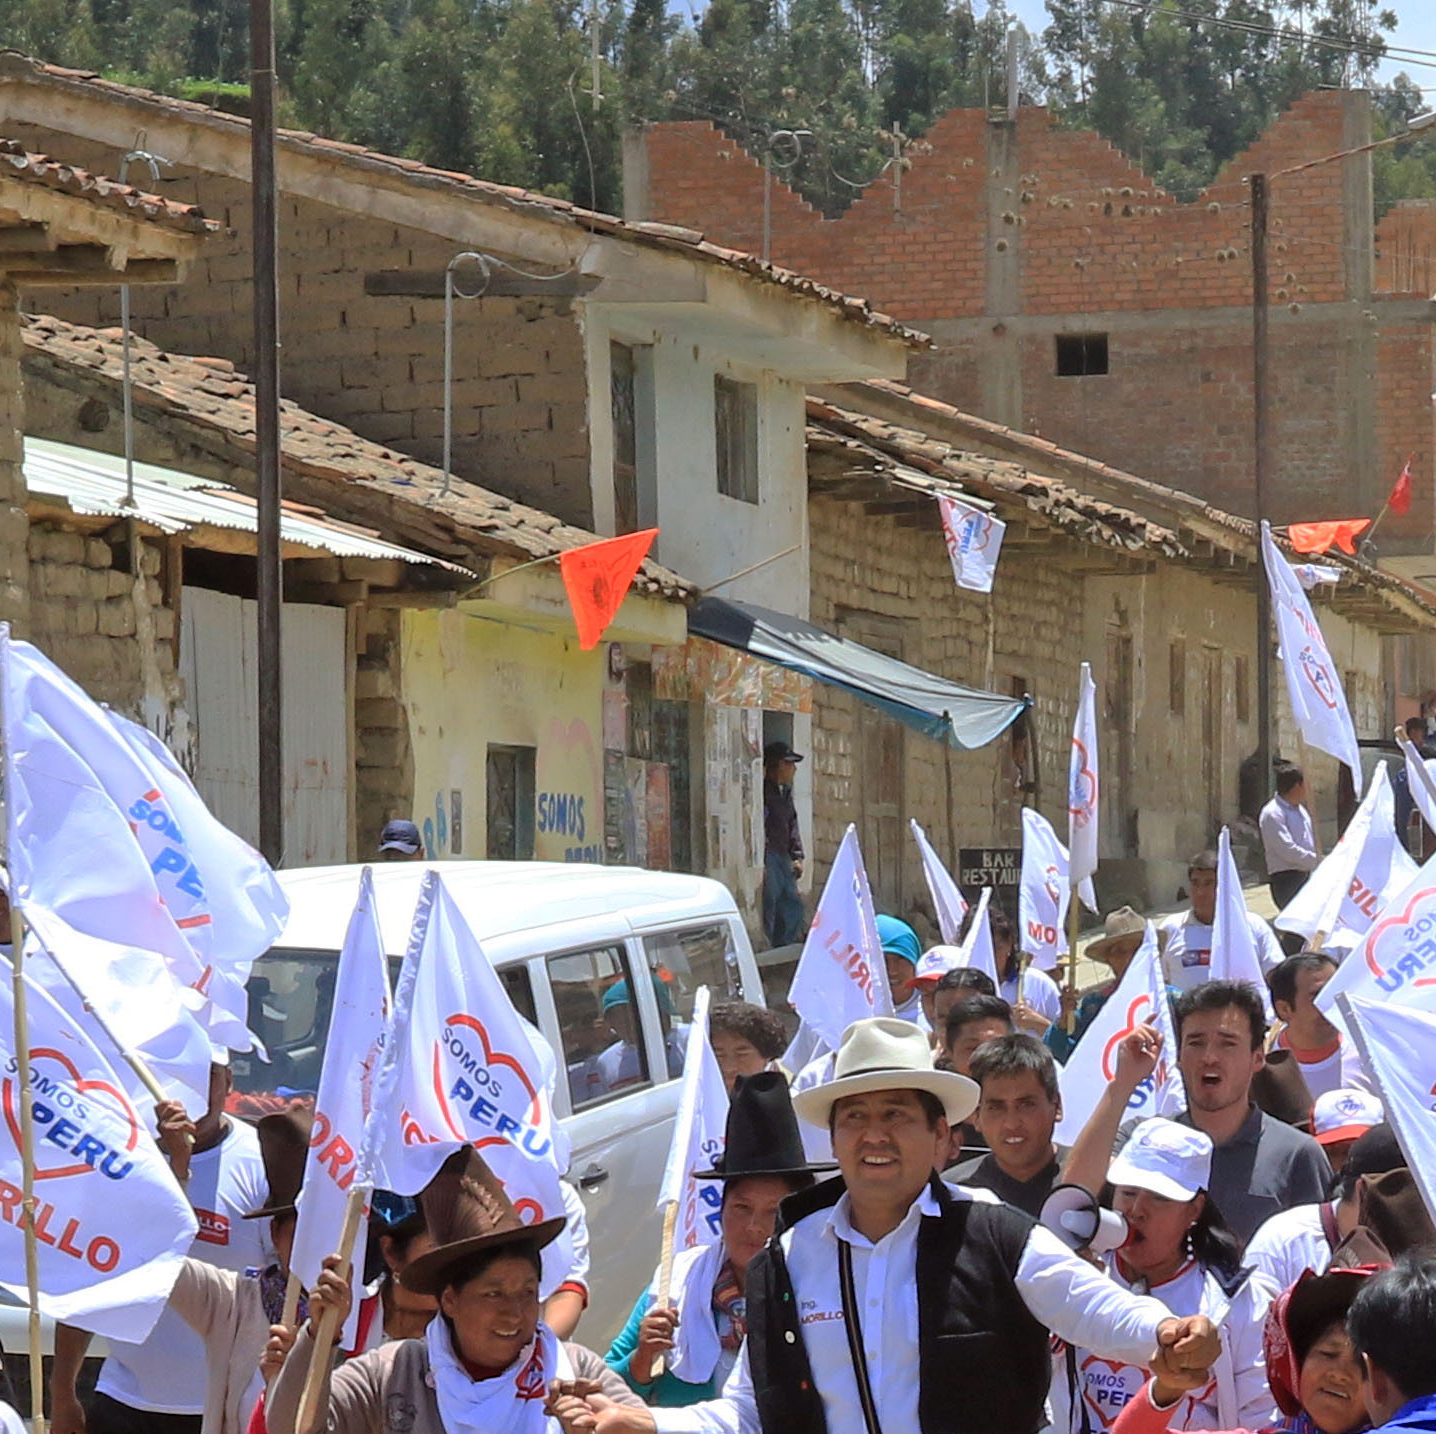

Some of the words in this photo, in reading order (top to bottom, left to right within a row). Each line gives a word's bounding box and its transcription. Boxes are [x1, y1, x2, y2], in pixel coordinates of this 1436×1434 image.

[537, 792, 586, 842] SOMOS
[982, 852, 1014, 867] BAR
[442, 1027, 503, 1099] SOMOS
[449, 1076, 551, 1157] PERU
